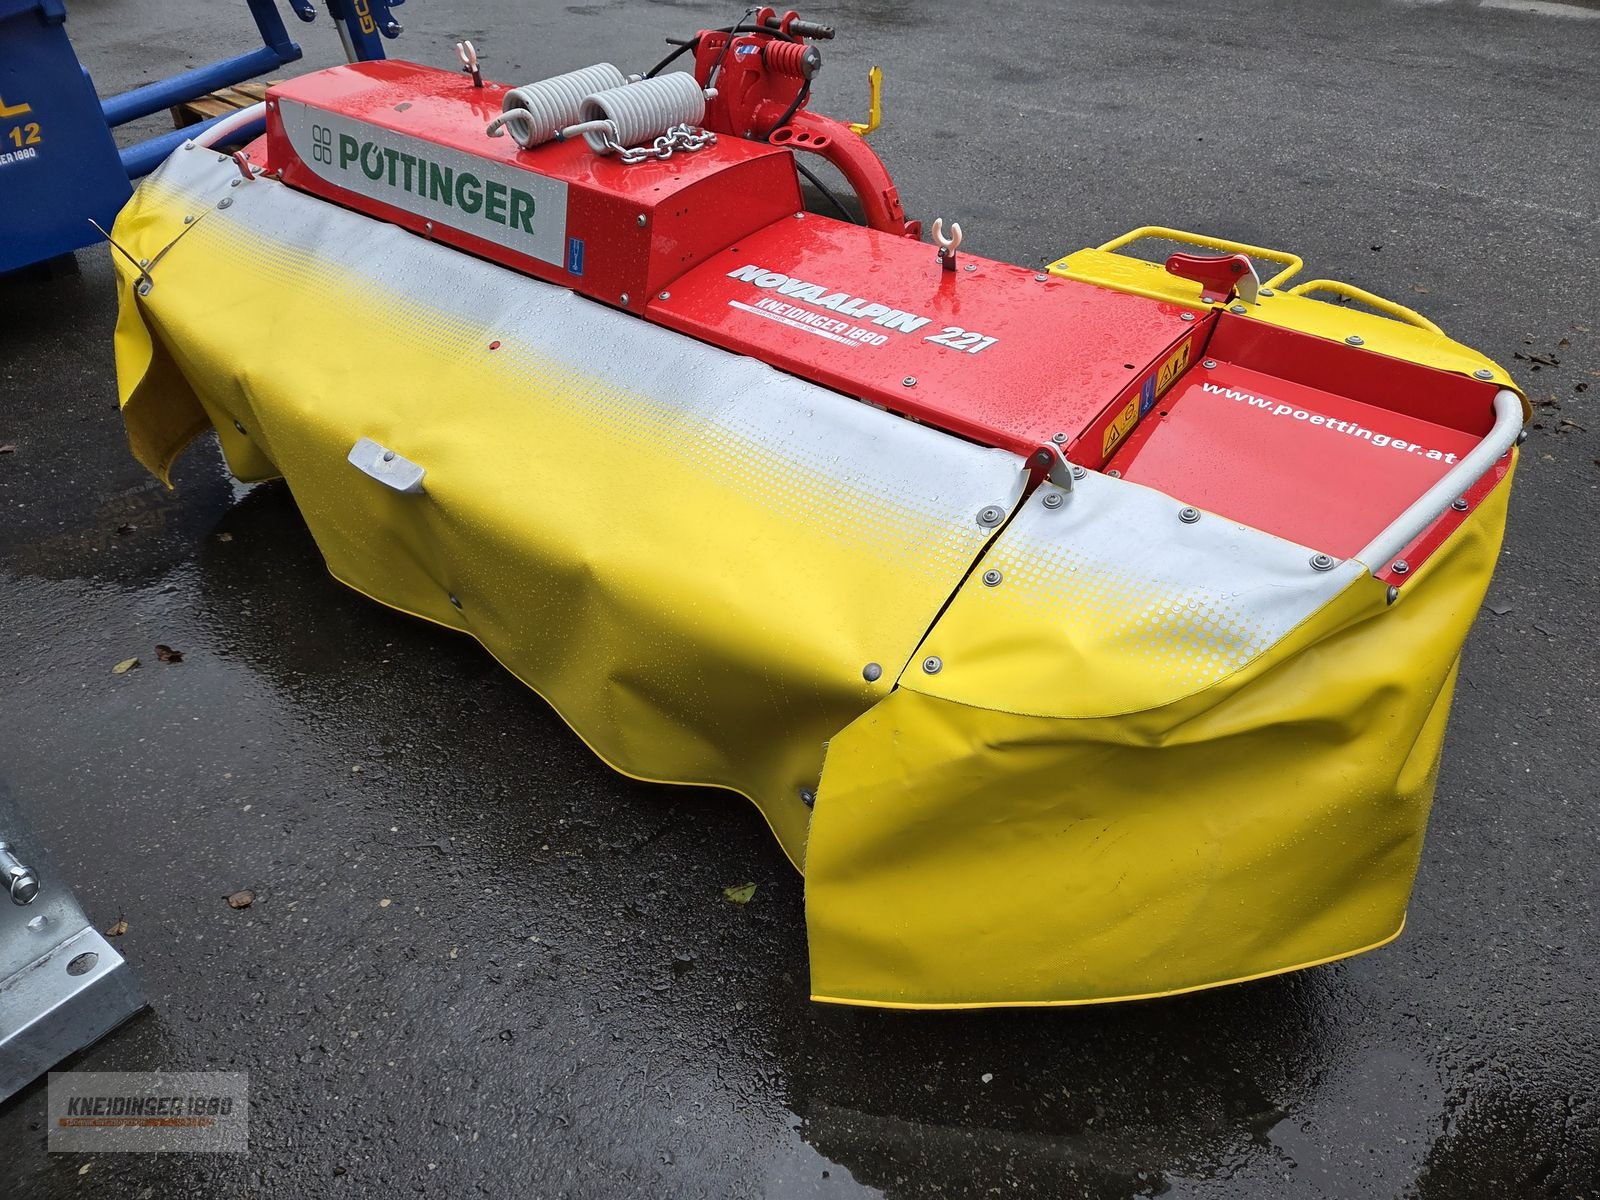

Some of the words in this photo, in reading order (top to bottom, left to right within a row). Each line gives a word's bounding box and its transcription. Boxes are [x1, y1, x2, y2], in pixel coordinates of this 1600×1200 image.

[9, 122, 41, 147] 12
[13, 147, 36, 161] 1880
[339, 133, 536, 235] PÖTTINGER
[726, 264, 933, 333] NOVAALPIN
[924, 326, 999, 354] 221
[754, 297, 849, 334] KNEIDINGER
[844, 326, 889, 346] 1880
[1202, 382, 1458, 464] www.poettinger.at
